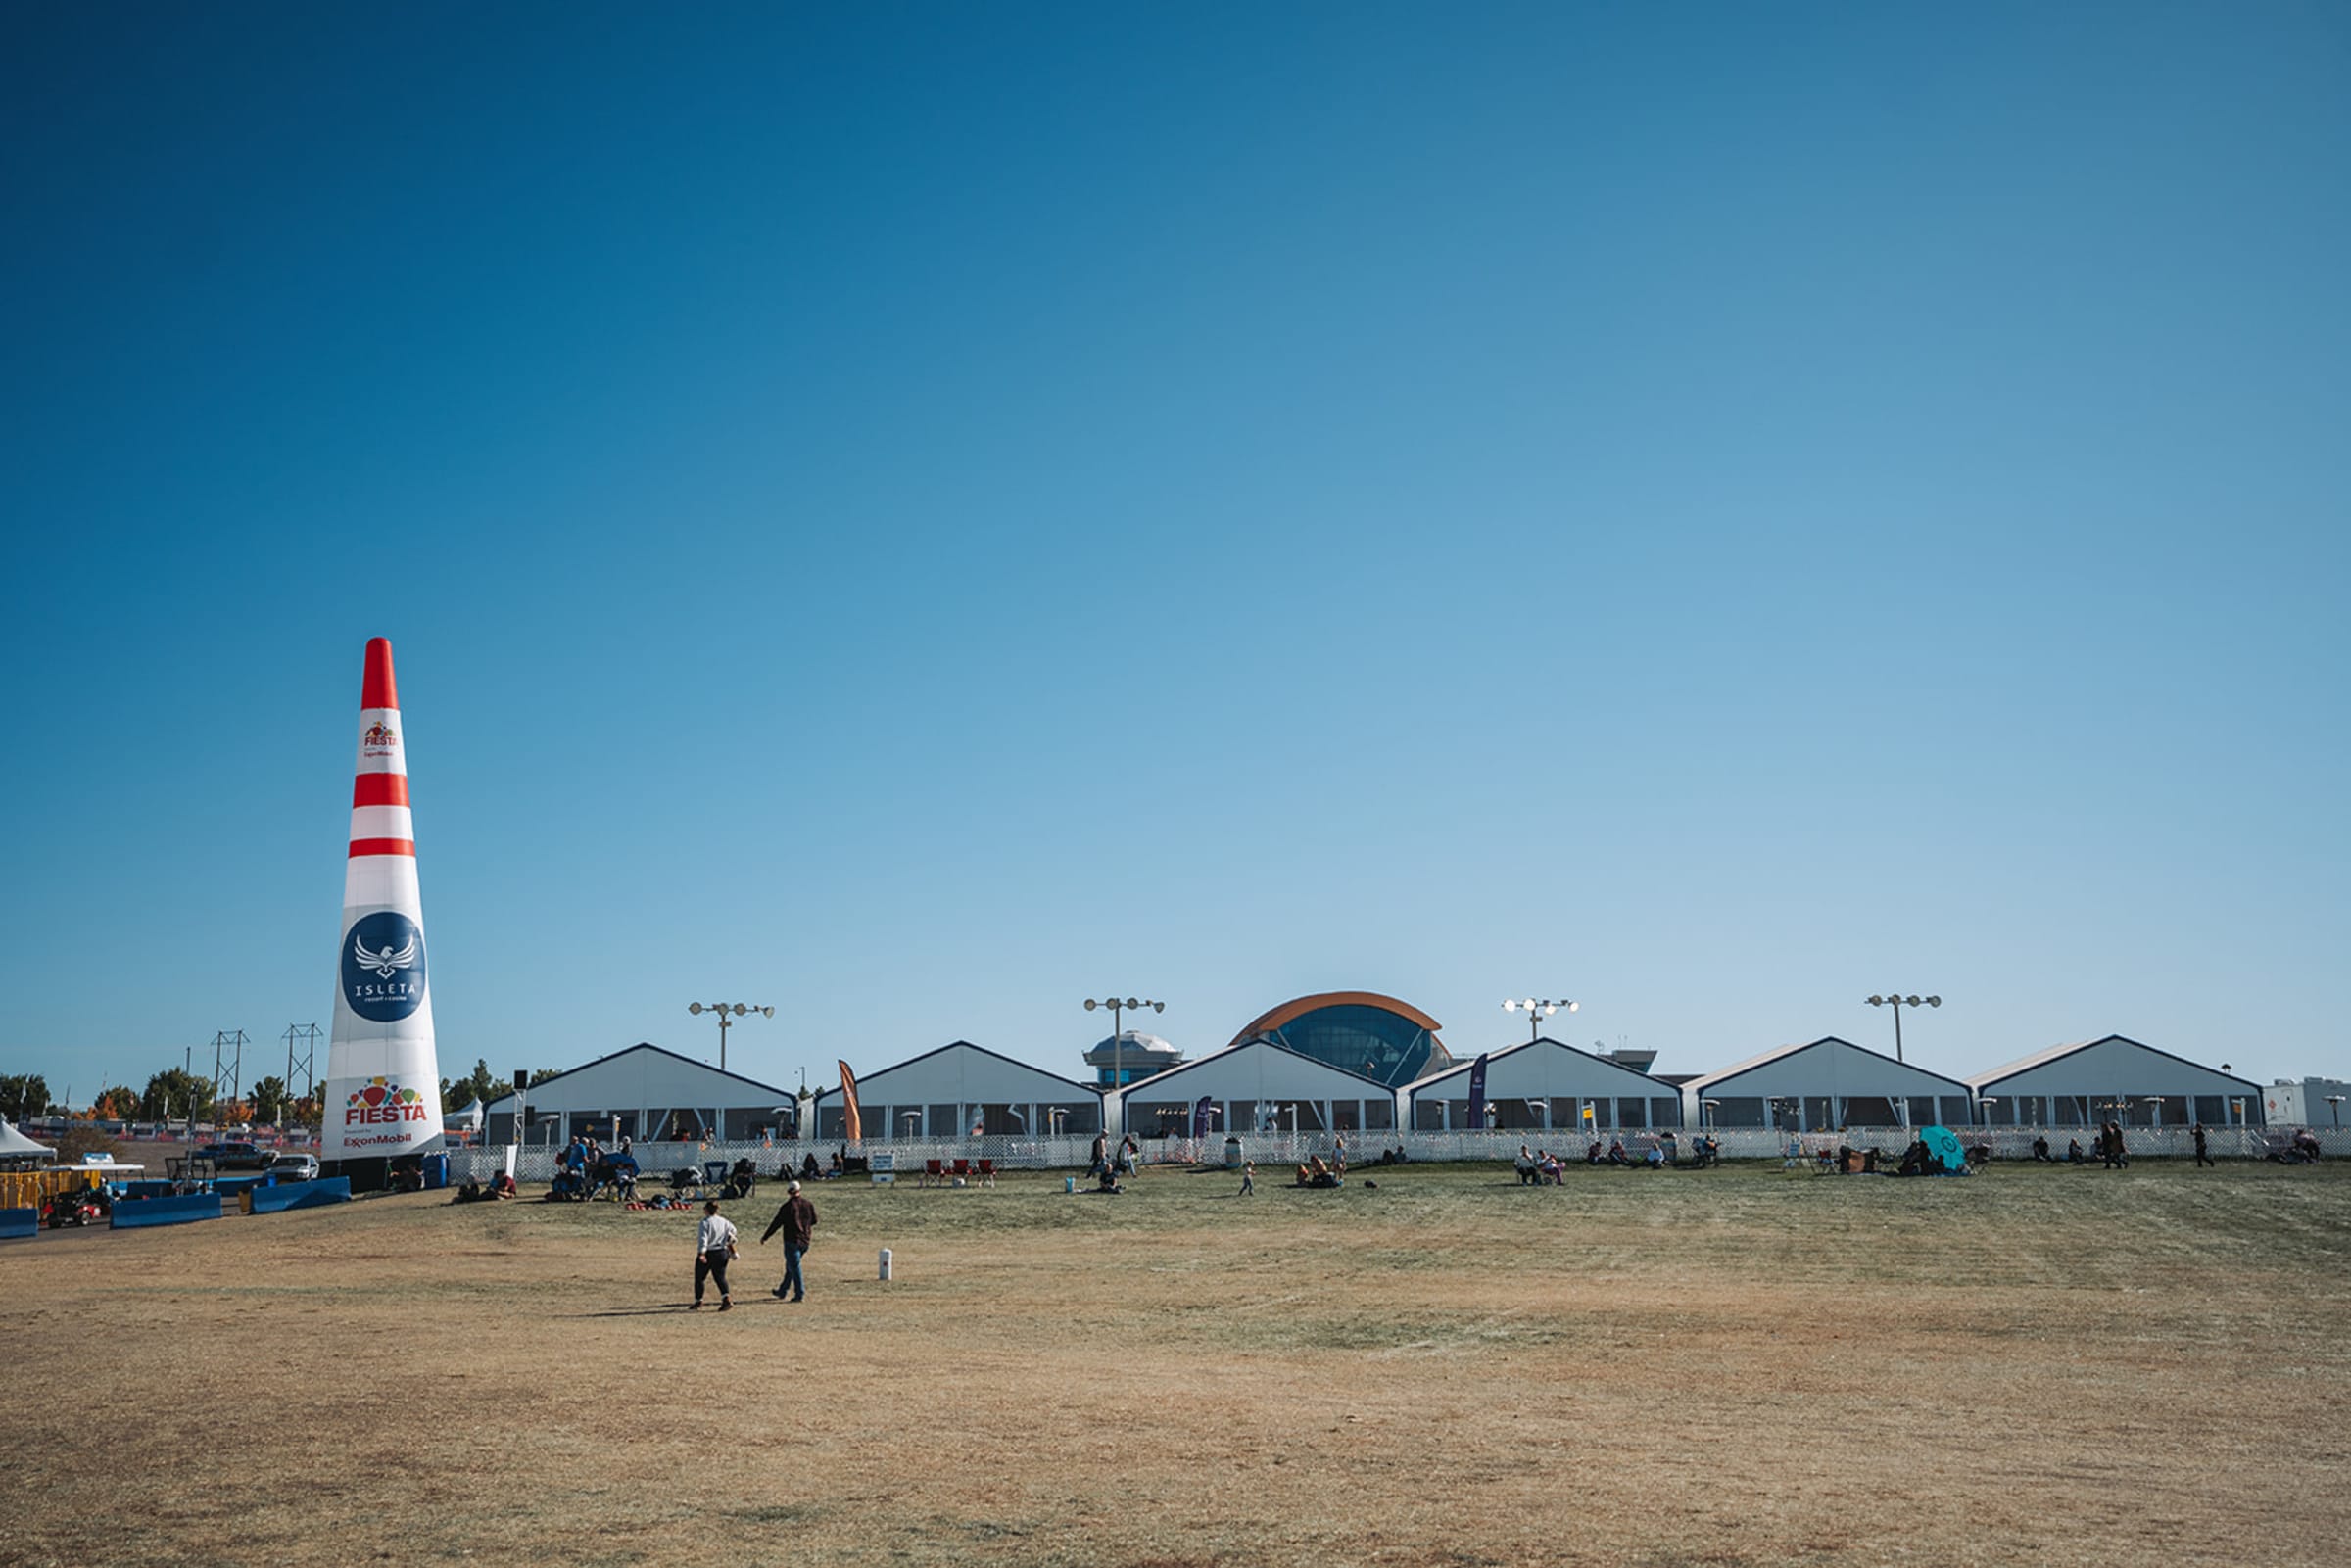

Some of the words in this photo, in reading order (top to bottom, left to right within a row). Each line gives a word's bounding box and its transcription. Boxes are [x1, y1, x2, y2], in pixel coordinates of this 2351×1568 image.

[355, 983, 416, 997] ISLETA
[345, 1105, 427, 1126] FIESTA
[344, 1133, 412, 1148] ExxonMobil
